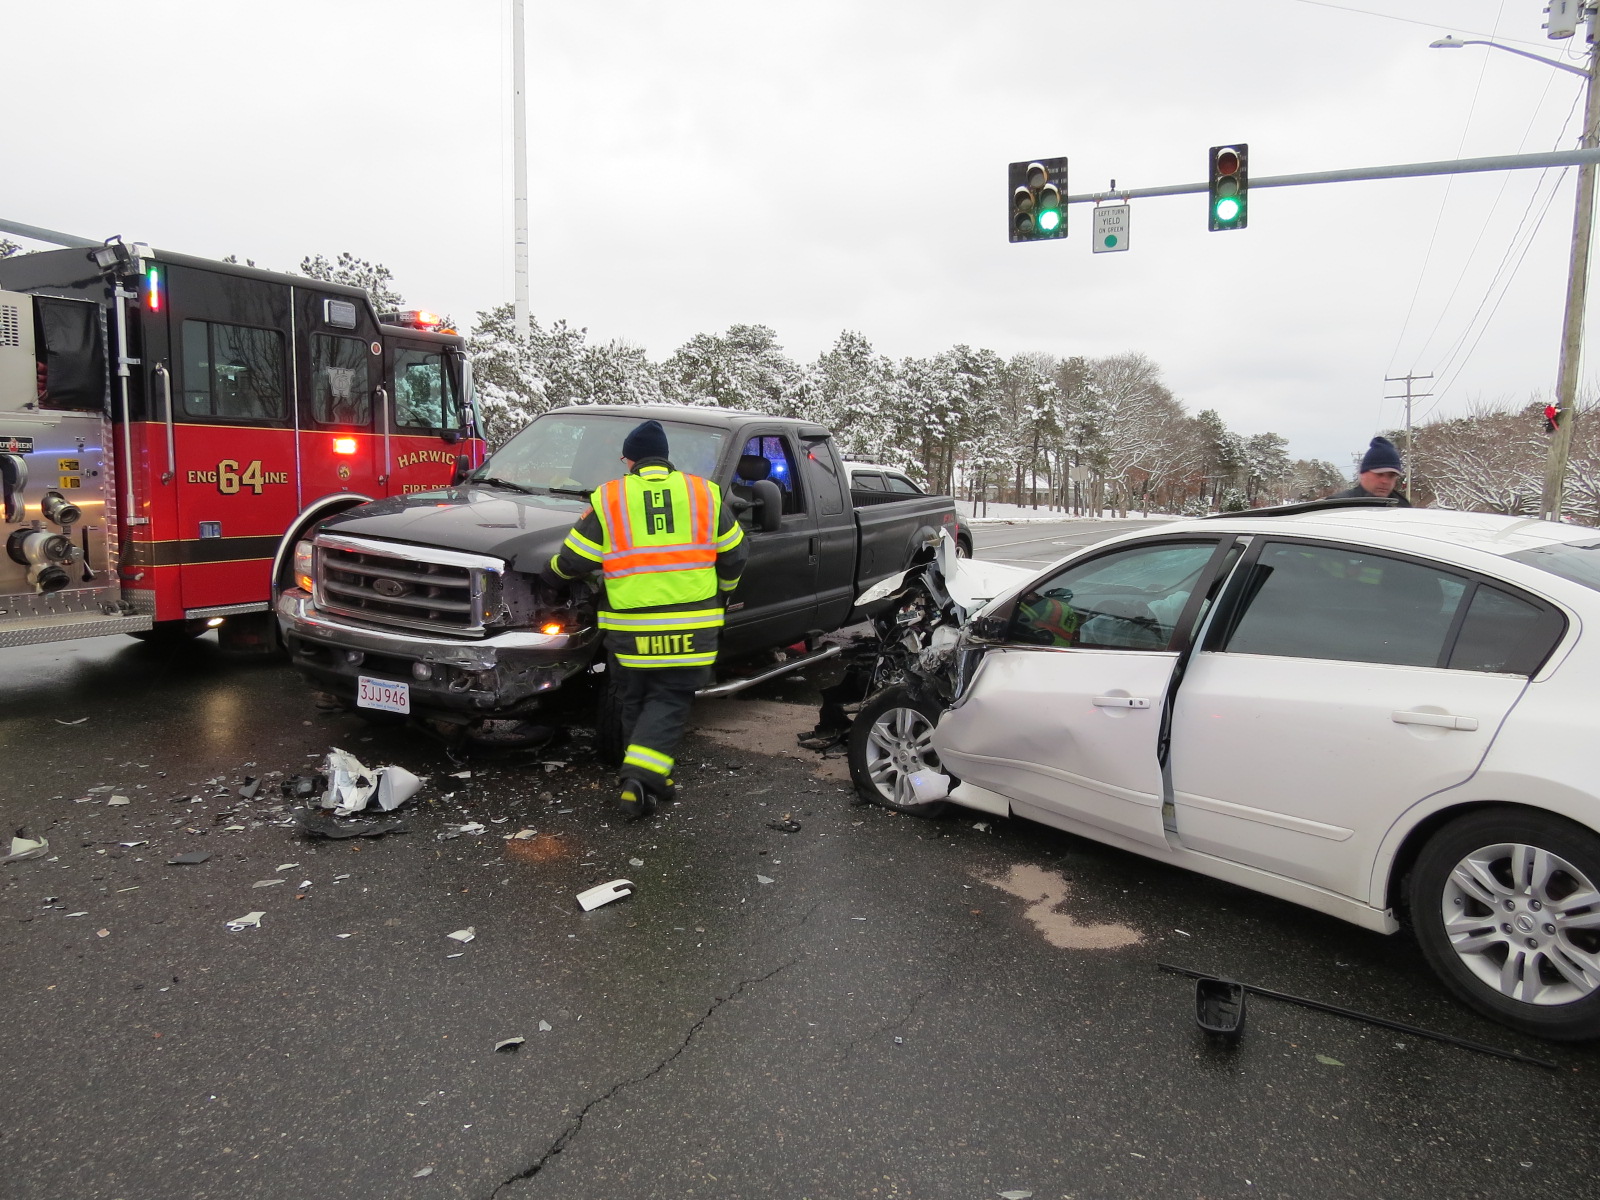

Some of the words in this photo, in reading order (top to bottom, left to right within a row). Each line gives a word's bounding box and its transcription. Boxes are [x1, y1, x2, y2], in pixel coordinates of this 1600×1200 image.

[1102, 217, 1121, 226] YIELD
[0, 441, 33, 449] UTPHEN
[397, 450, 458, 468] HARWIC
[217, 459, 264, 494] 64
[635, 633, 695, 654] WHITE
